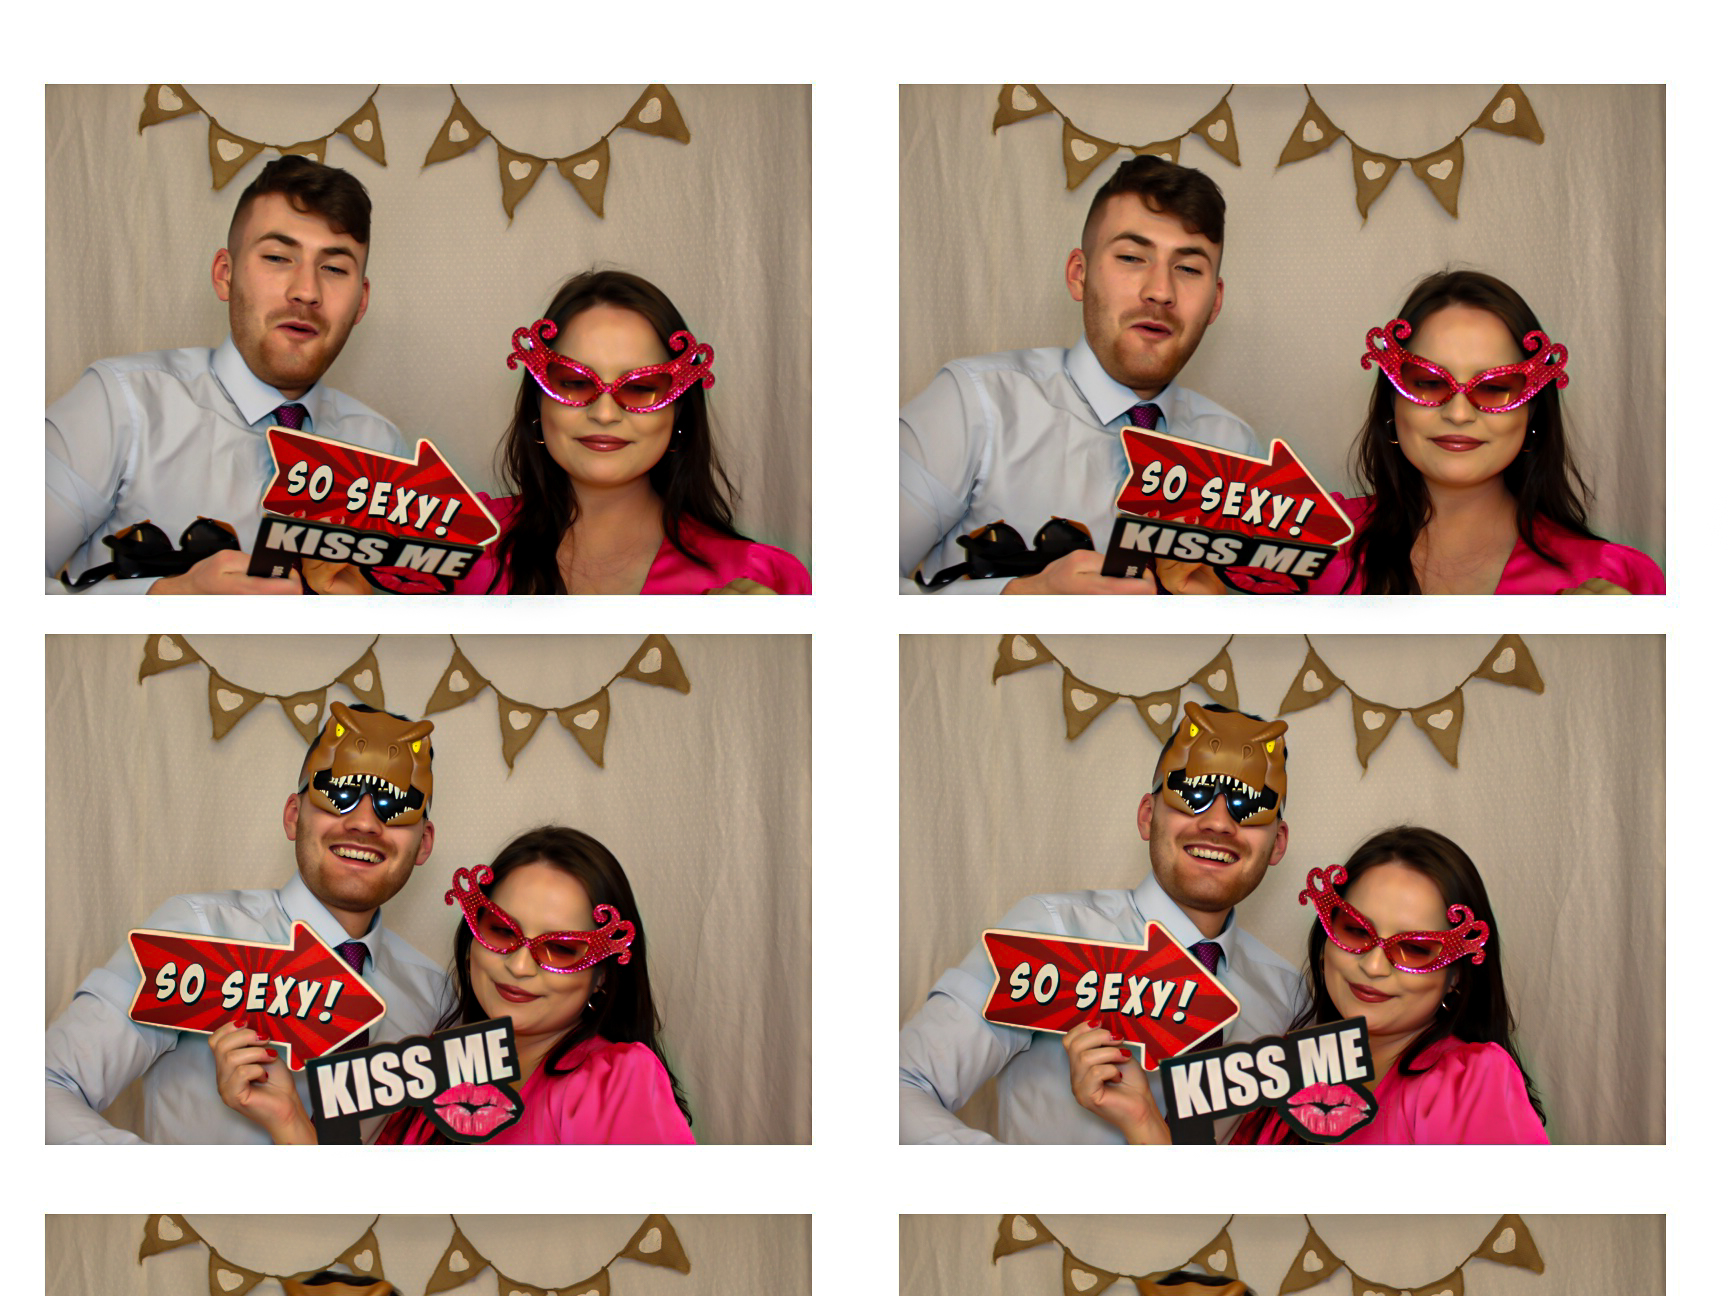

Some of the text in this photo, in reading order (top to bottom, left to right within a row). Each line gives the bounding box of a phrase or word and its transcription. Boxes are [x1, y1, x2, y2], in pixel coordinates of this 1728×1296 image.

[287, 461, 462, 536] SO SEXY!
[1141, 461, 1316, 536] SO SEXY!
[266, 522, 473, 576] KISS ME
[1120, 522, 1327, 576] KISS ME
[155, 962, 344, 1023] SO SEXY!
[1009, 962, 1198, 1023] SO SEXY!
[317, 1028, 513, 1119] KISS ME
[1171, 1028, 1367, 1119] KISS ME
